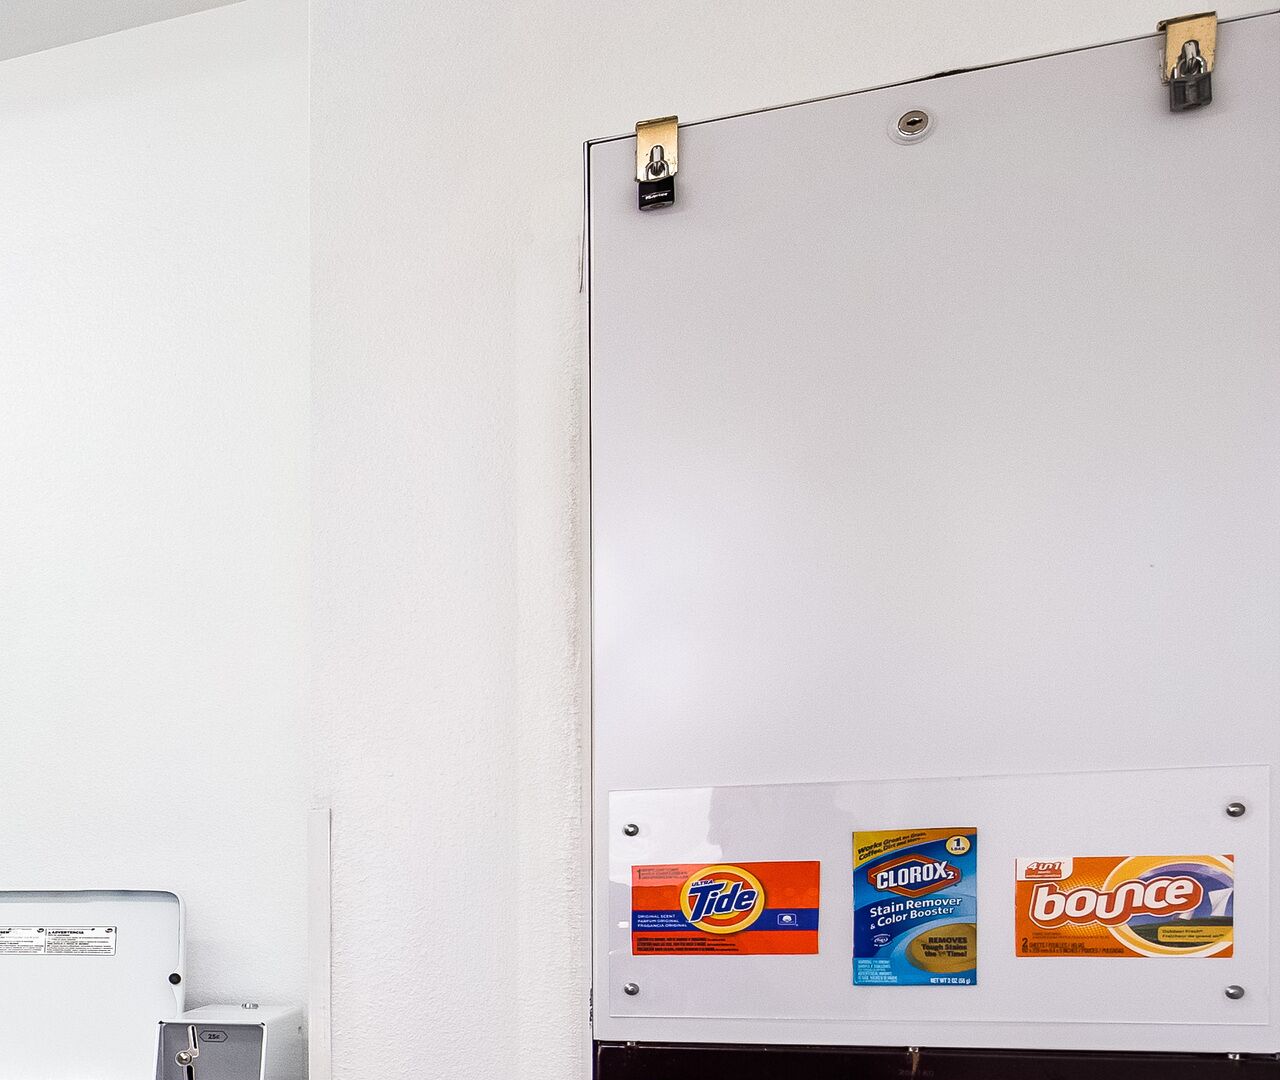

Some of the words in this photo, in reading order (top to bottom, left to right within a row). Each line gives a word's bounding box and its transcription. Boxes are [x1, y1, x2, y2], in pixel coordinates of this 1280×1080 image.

[857, 842, 882, 855] Works
[883, 836, 902, 845] Great
[953, 837, 962, 847] 1
[691, 879, 714, 887] ULTRA
[689, 882, 758, 922] Tide
[869, 902, 904, 918] Stain
[906, 897, 962, 910] Remover
[1033, 878, 1195, 921] bounce
[877, 913, 908, 927] Color
[910, 906, 954, 919] Booster
[921, 943, 944, 951] Tough
[928, 936, 968, 944] REMOVES
